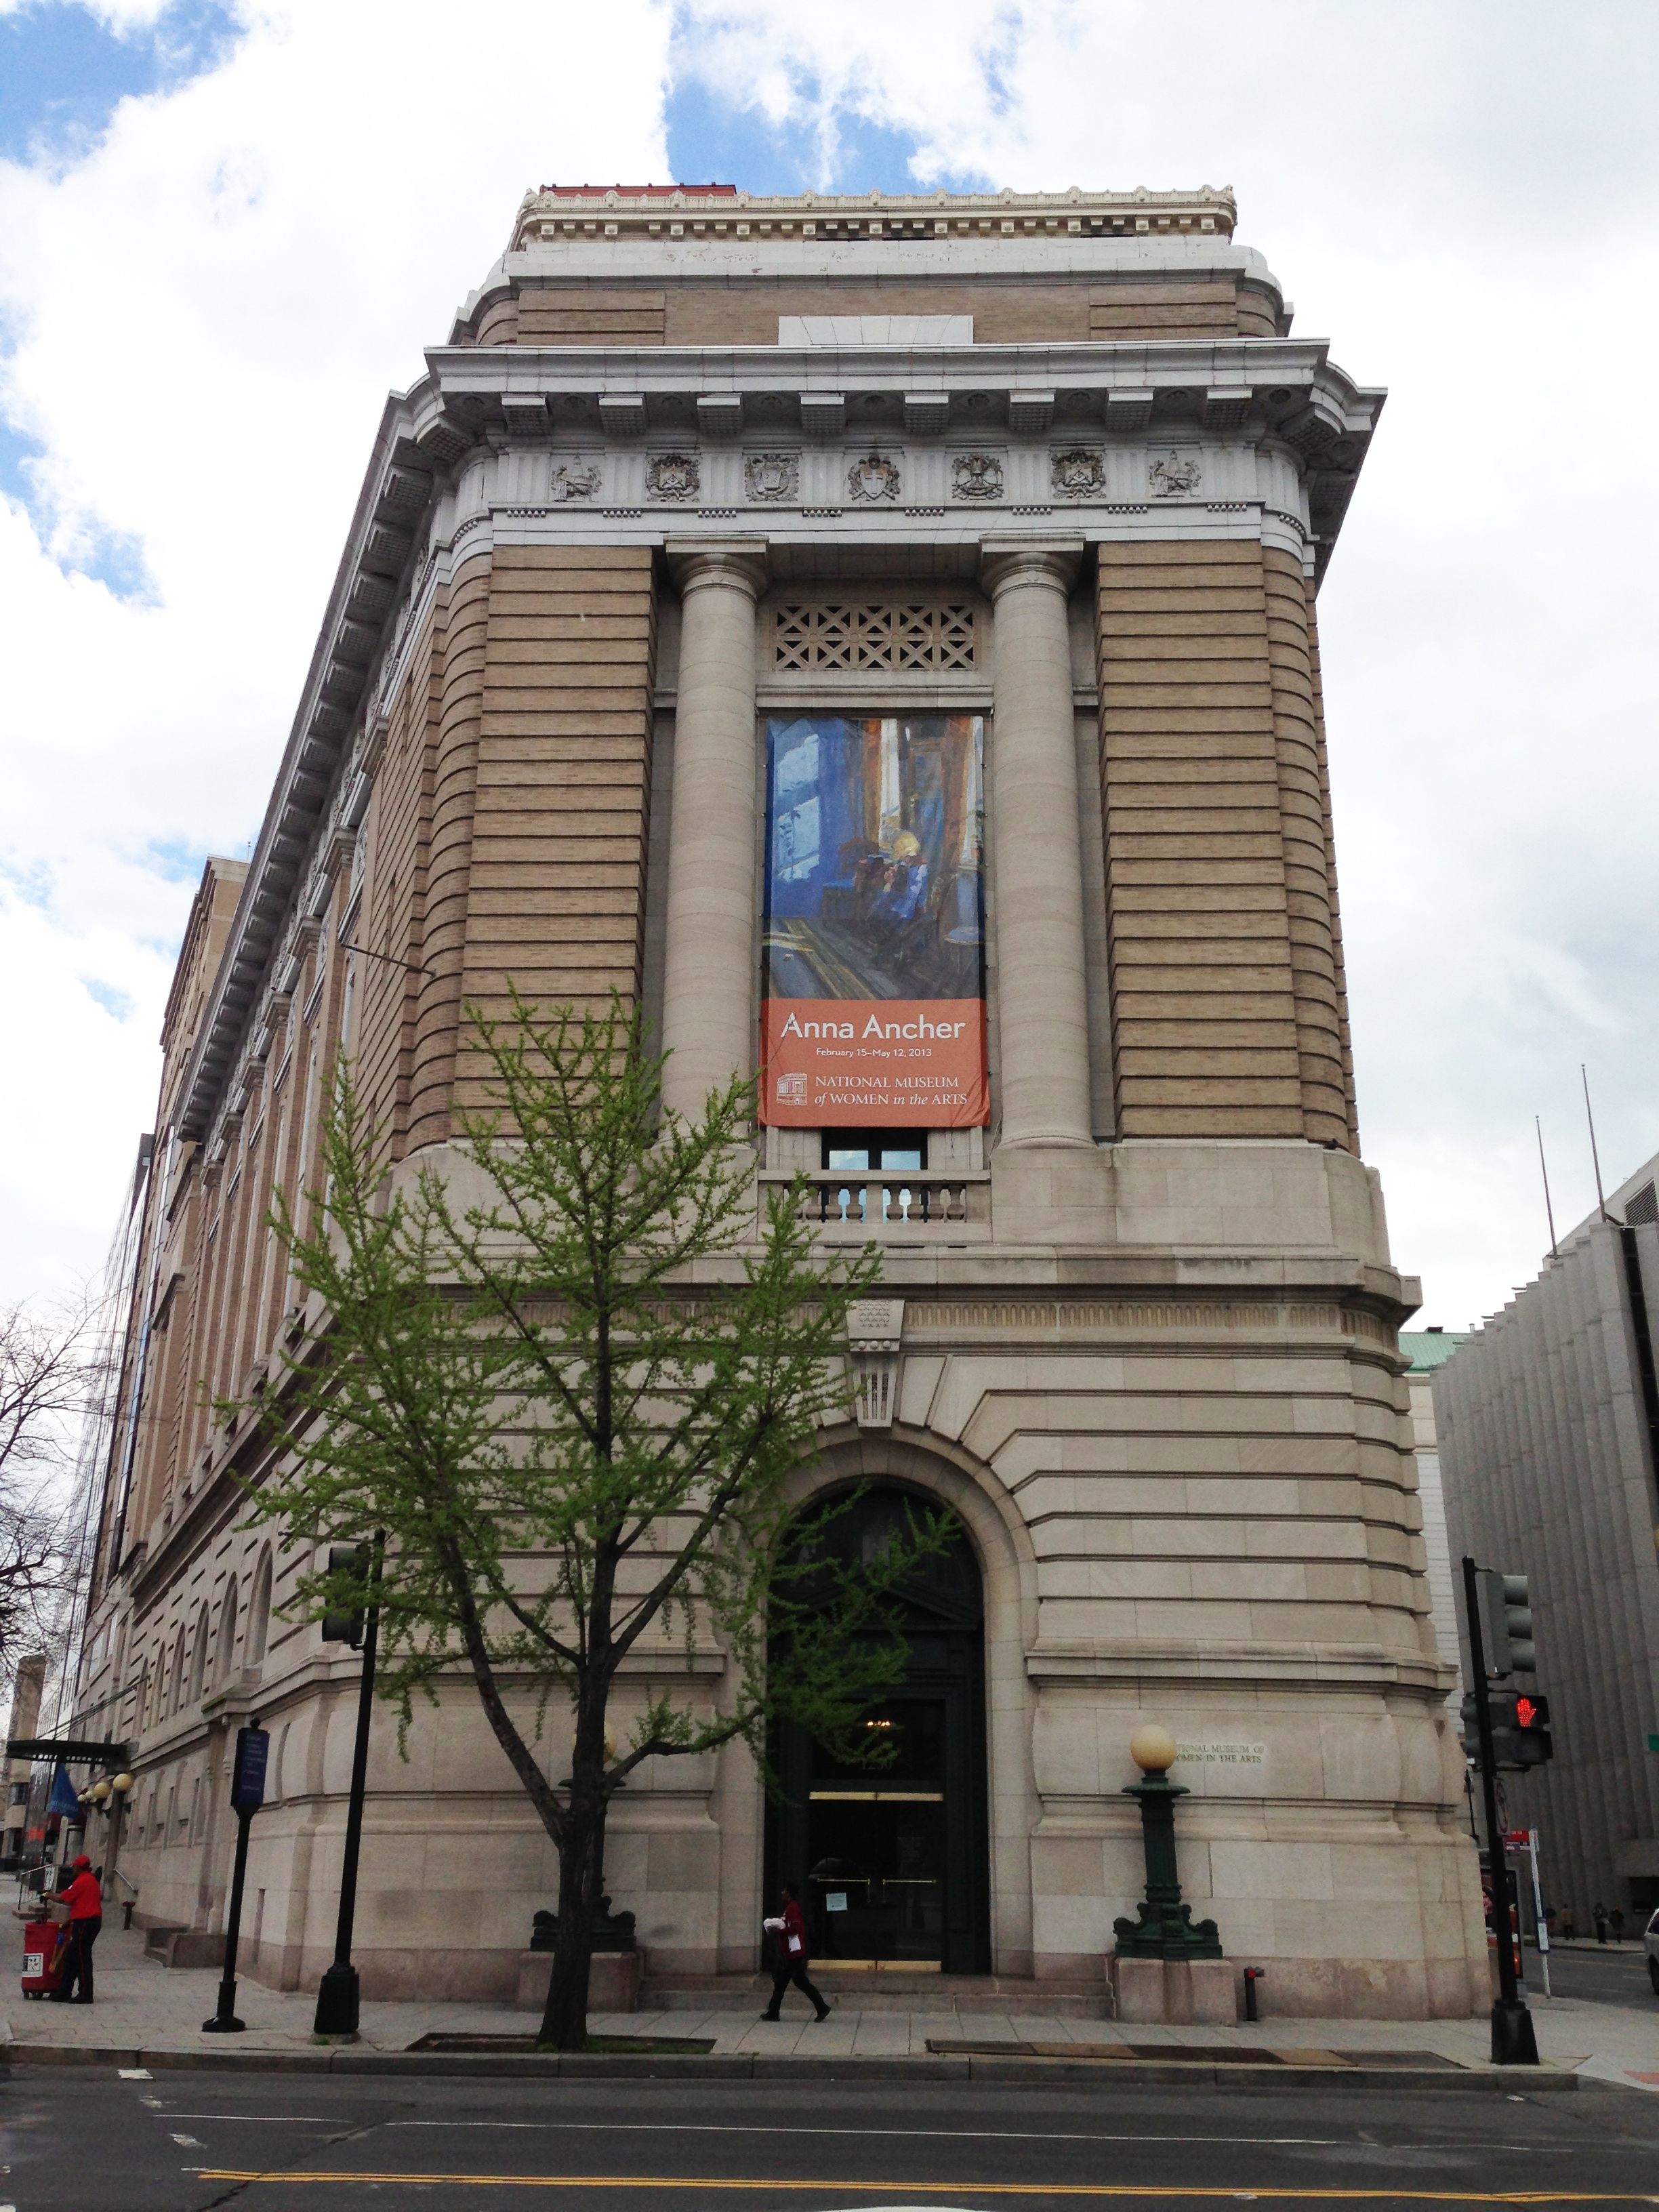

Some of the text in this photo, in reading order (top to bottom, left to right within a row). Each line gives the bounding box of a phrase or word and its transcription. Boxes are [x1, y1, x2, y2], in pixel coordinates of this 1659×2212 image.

[781, 1012, 966, 1040] Anna Ancher
[816, 1047, 854, 1057] February
[893, 1049, 907, 1058] 12,
[909, 1048, 933, 1057] 2013
[815, 1076, 959, 1088] NATIONAL MUSEUM
[815, 1092, 967, 1107] of WOMEN in the ARTS
[1212, 1744, 1249, 1753] MUSEUM
[1253, 1745, 1265, 1753] OF
[1176, 1754, 1262, 1763] OMEN IN THE ARTS
